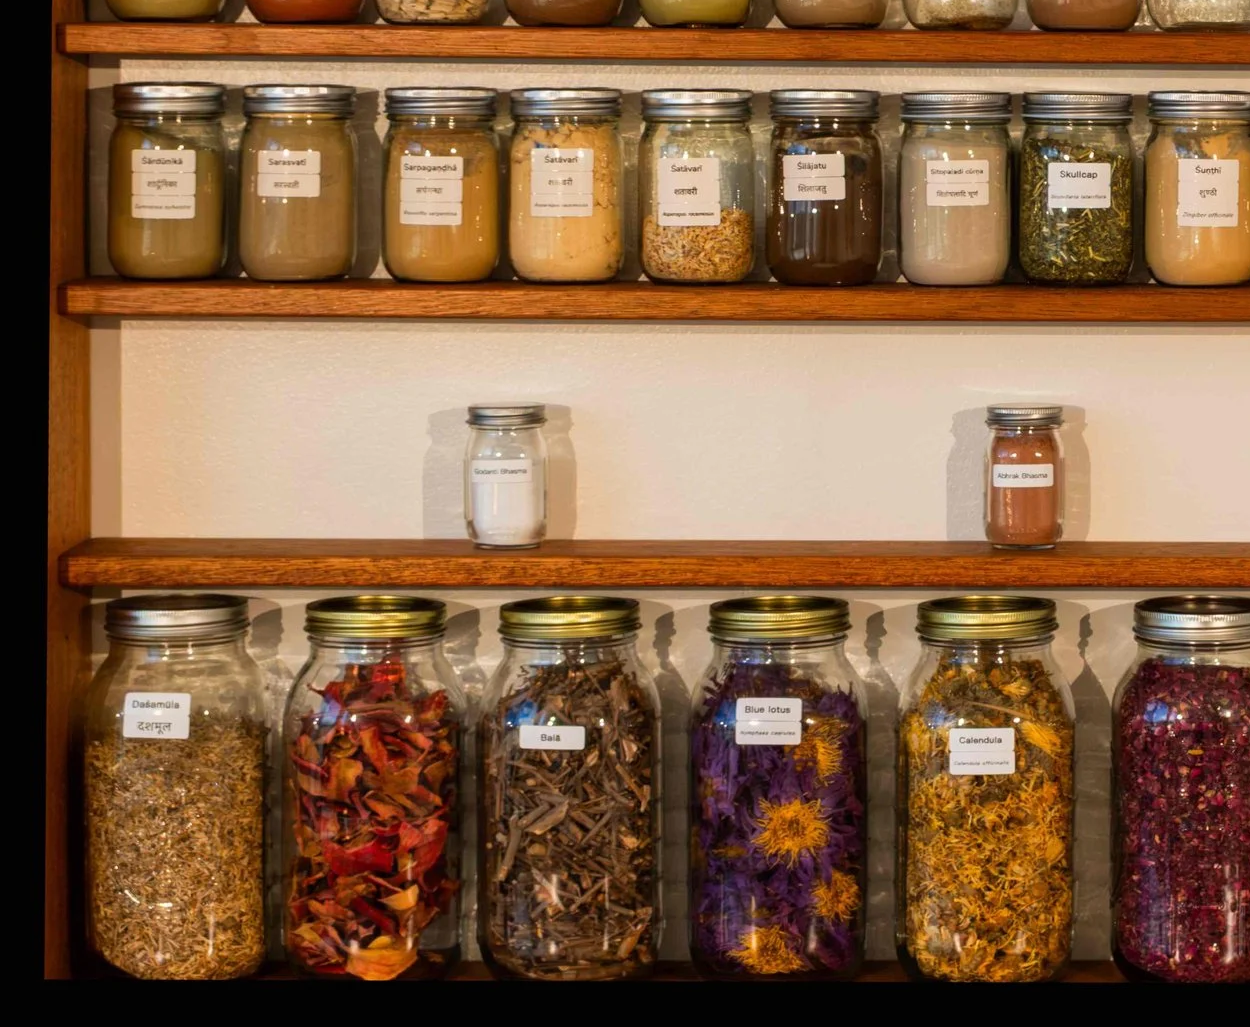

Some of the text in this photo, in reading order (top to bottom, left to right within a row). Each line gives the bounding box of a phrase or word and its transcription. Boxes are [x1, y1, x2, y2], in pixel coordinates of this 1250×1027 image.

[797, 162, 826, 170] Śilājatu
[1060, 171, 1097, 179] Skullcap
[132, 700, 180, 709] Daśamūla
[137, 722, 172, 734] दशमूल
